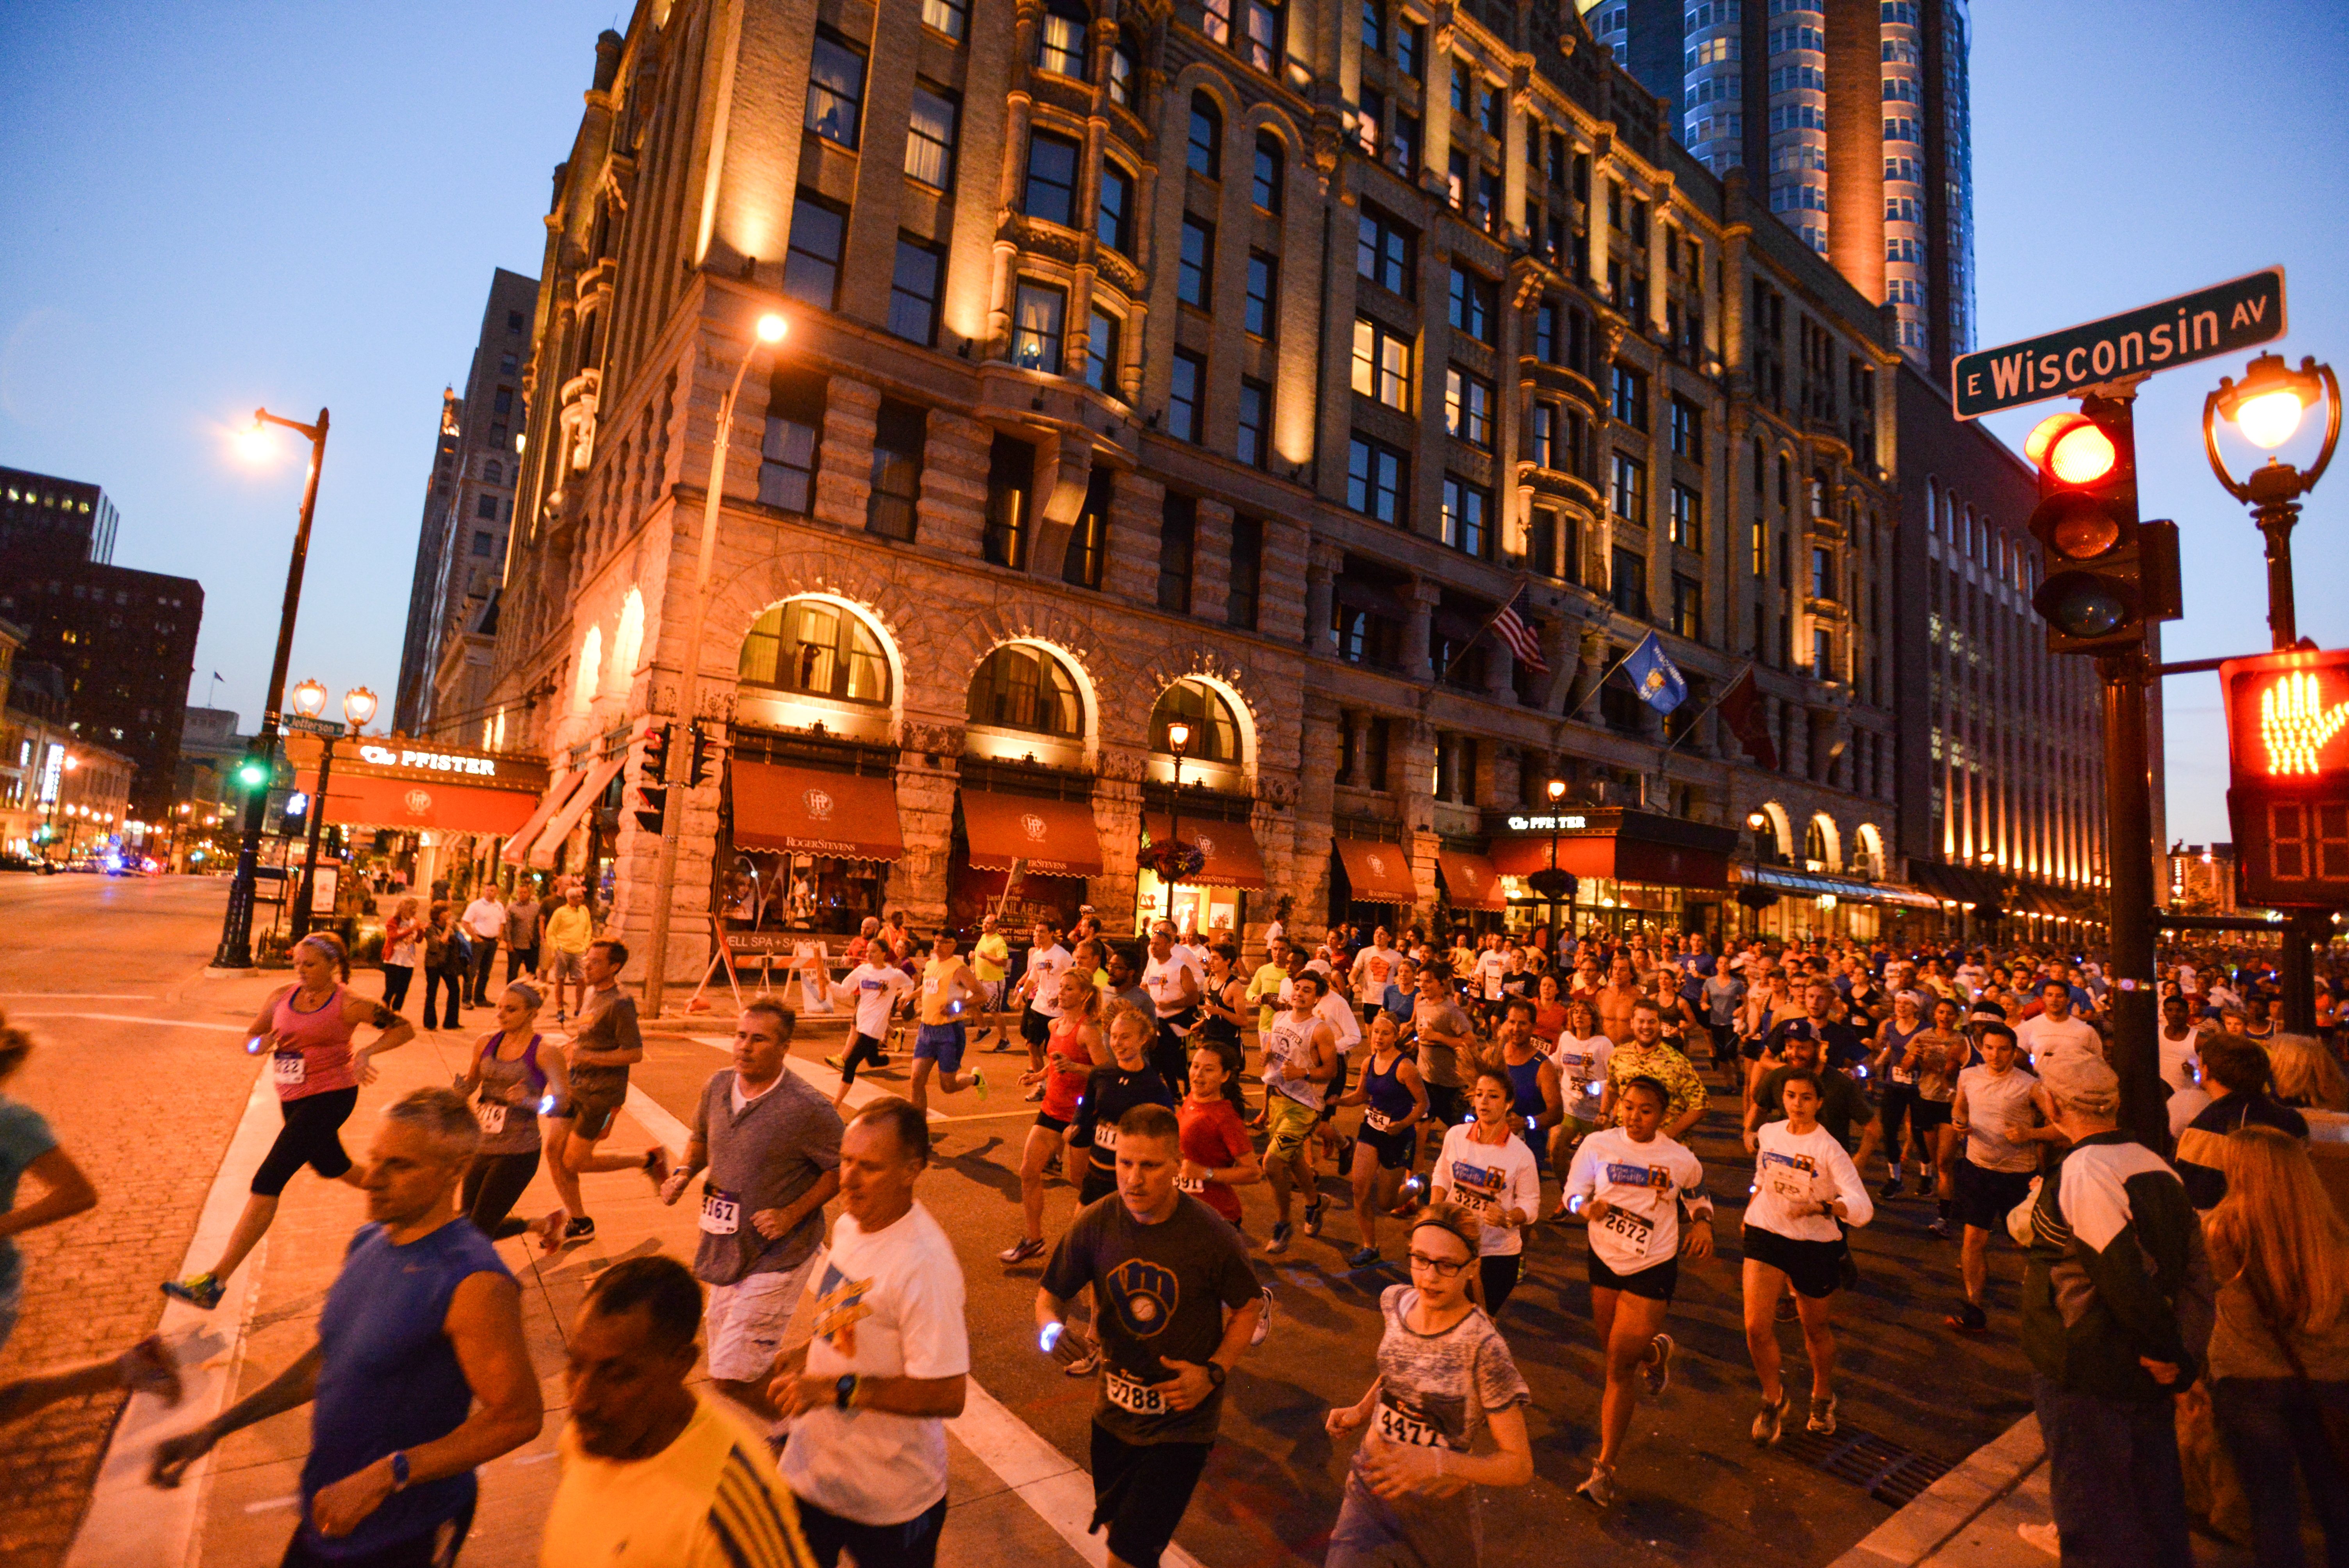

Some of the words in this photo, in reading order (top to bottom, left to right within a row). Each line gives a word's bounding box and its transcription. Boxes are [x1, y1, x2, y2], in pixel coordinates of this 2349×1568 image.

[1968, 373, 1982, 396] E
[1990, 307, 2219, 399] Wisconsin
[2231, 295, 2267, 330] AV
[289, 717, 334, 732] Jefferson
[360, 745, 396, 765] The
[401, 750, 495, 776] PFISTER
[1012, 856, 1067, 870] RERSTEVENS
[751, 937, 773, 947] SPA
[782, 937, 820, 948] SAON
[1605, 1213, 1647, 1244] 2672
[1382, 1410, 1440, 1447] 4477
